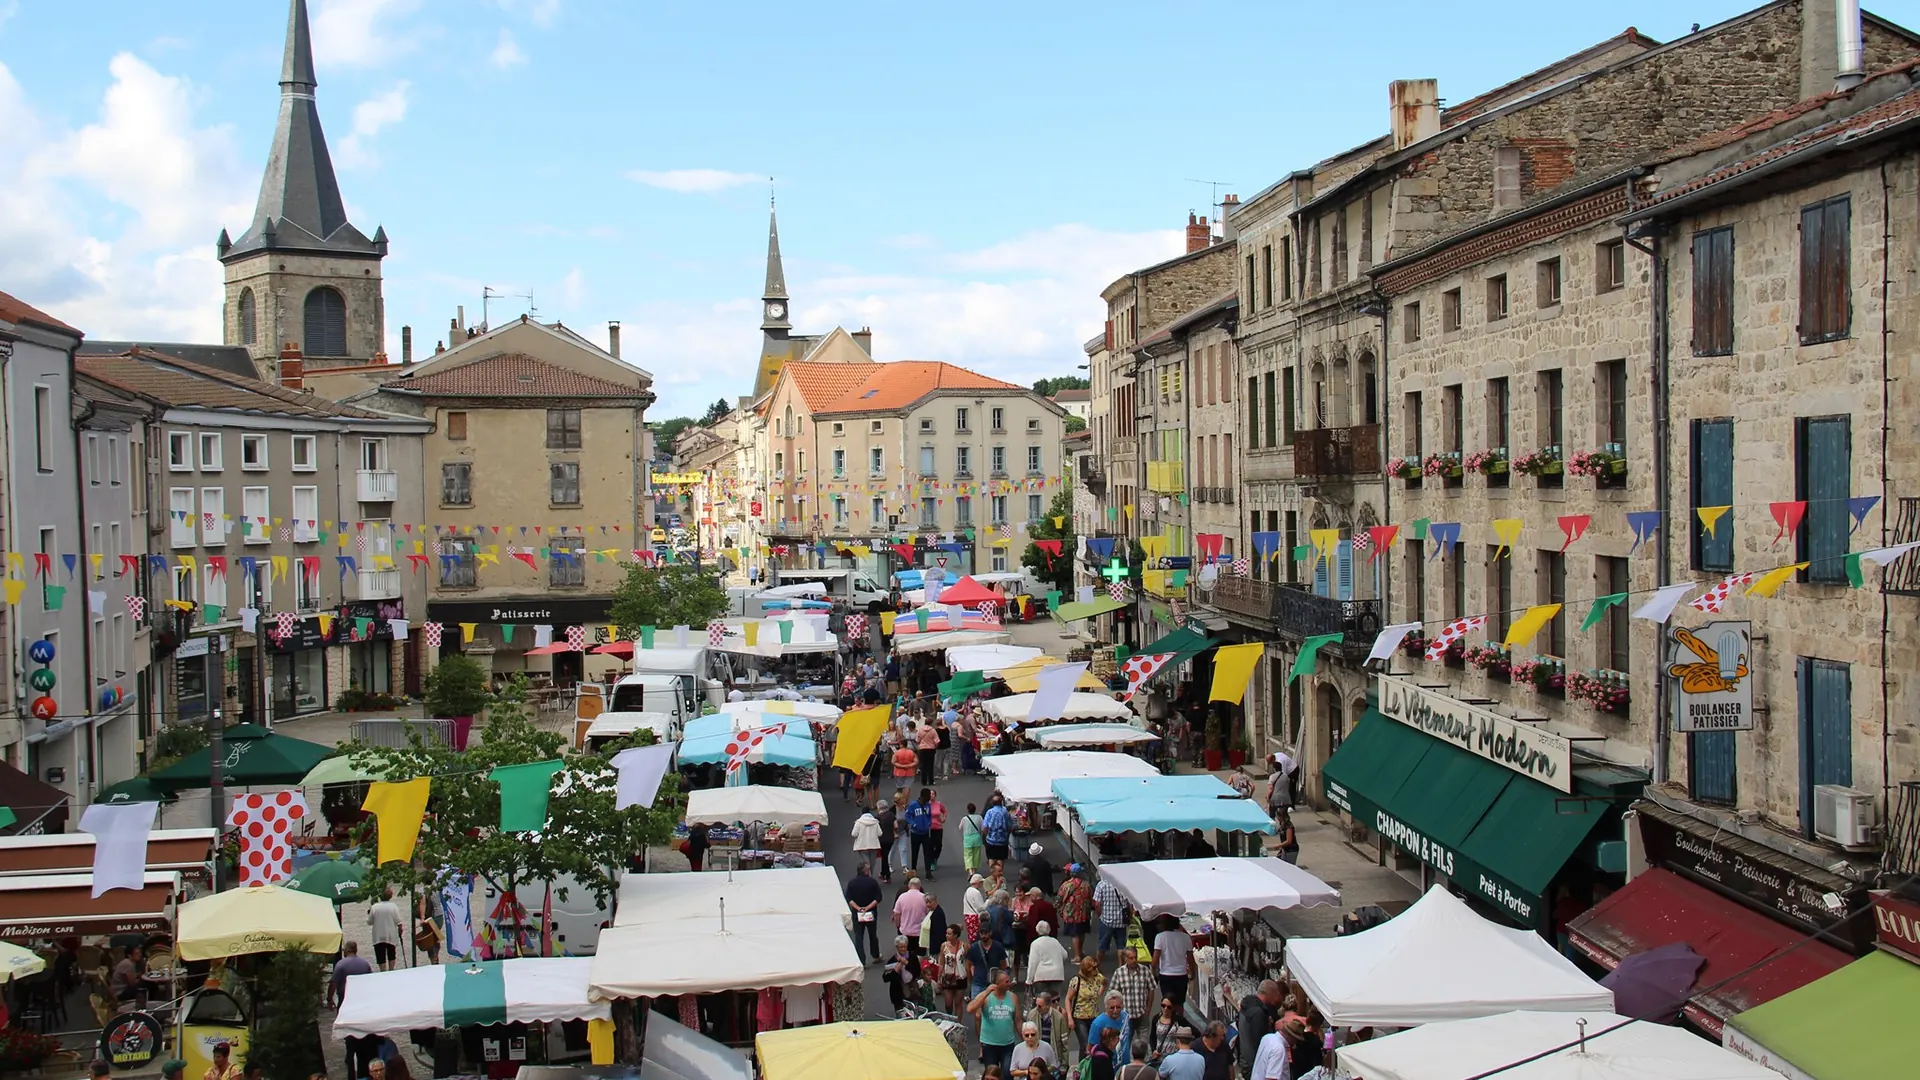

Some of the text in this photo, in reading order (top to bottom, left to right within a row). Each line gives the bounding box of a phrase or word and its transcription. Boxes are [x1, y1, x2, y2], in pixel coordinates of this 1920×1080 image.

[490, 608, 551, 620] Patisserie
[1689, 703, 1741, 716] BOULANGER
[1693, 715, 1739, 728] PATISSIER
[1384, 682, 1557, 778] Le Vêtement Modern
[1376, 810, 1454, 876] CHAPPON & FILS
[1675, 831, 1724, 864] Boulangerie
[1735, 855, 1781, 889] Pâtisserie
[1786, 879, 1796, 897] &
[1479, 873, 1531, 918] Prêt à Porter
[1, 925, 51, 937] Madison
[140, 922, 158, 930] VINS
[112, 1051, 151, 1064] MOTARD
